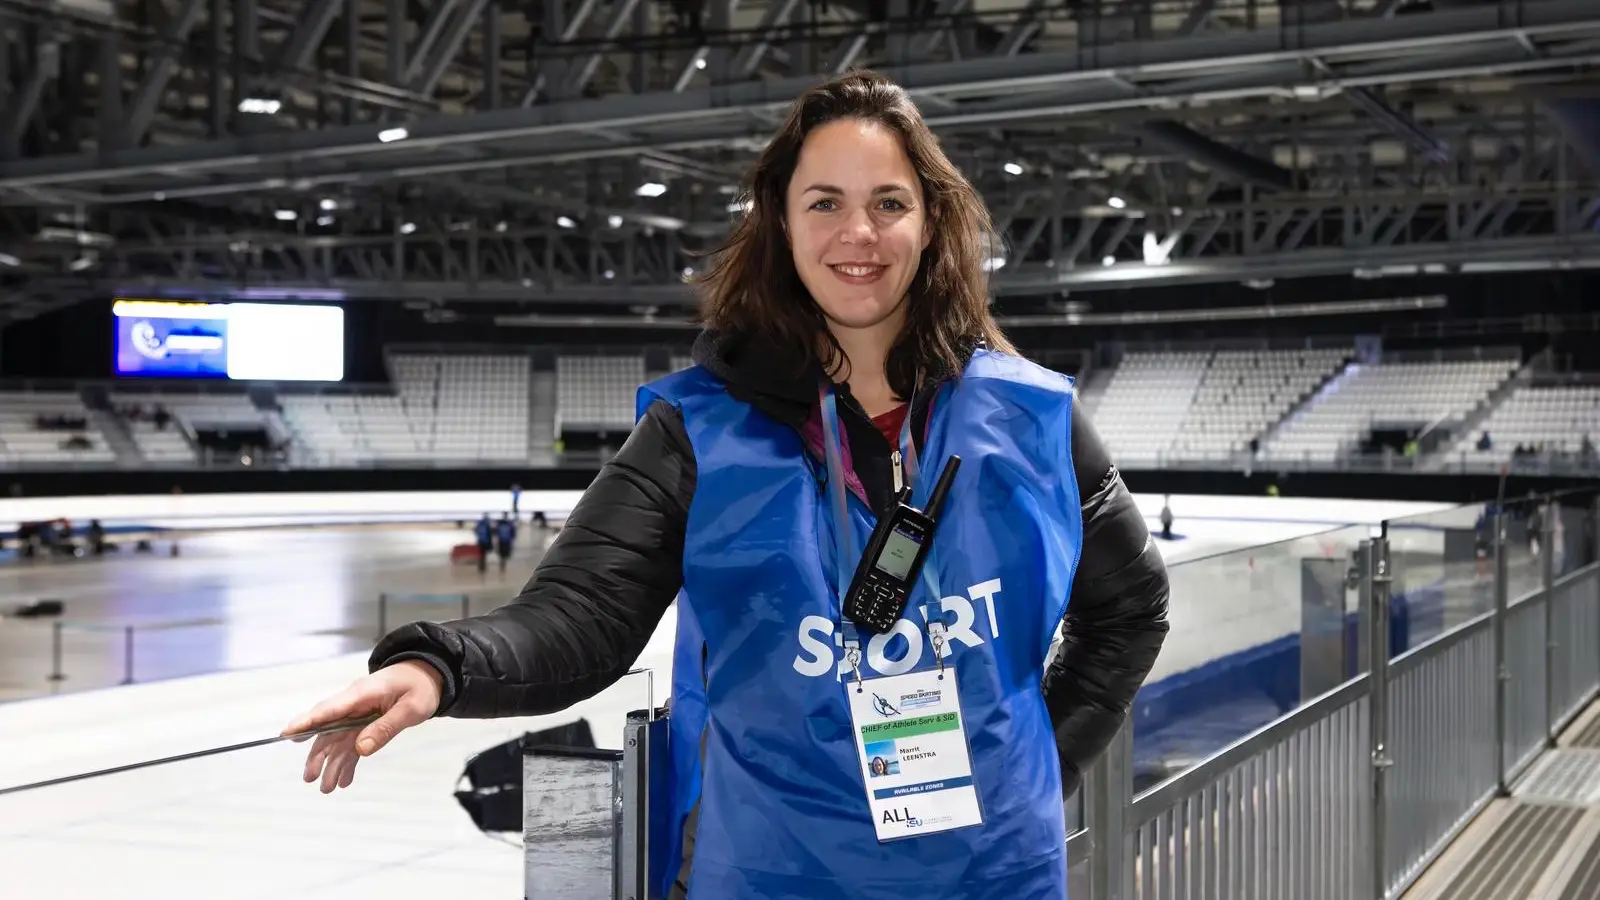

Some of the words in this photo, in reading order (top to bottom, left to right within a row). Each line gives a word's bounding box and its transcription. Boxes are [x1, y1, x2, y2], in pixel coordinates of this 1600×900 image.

[861, 724, 882, 734] CHIEF
[892, 720, 917, 729] Athlete
[899, 746, 920, 755] Marrit
[903, 751, 937, 762] LEENSTRA
[894, 786, 925, 795] AVAILABLE
[925, 783, 944, 791] ZONES
[882, 807, 916, 824] ALL
